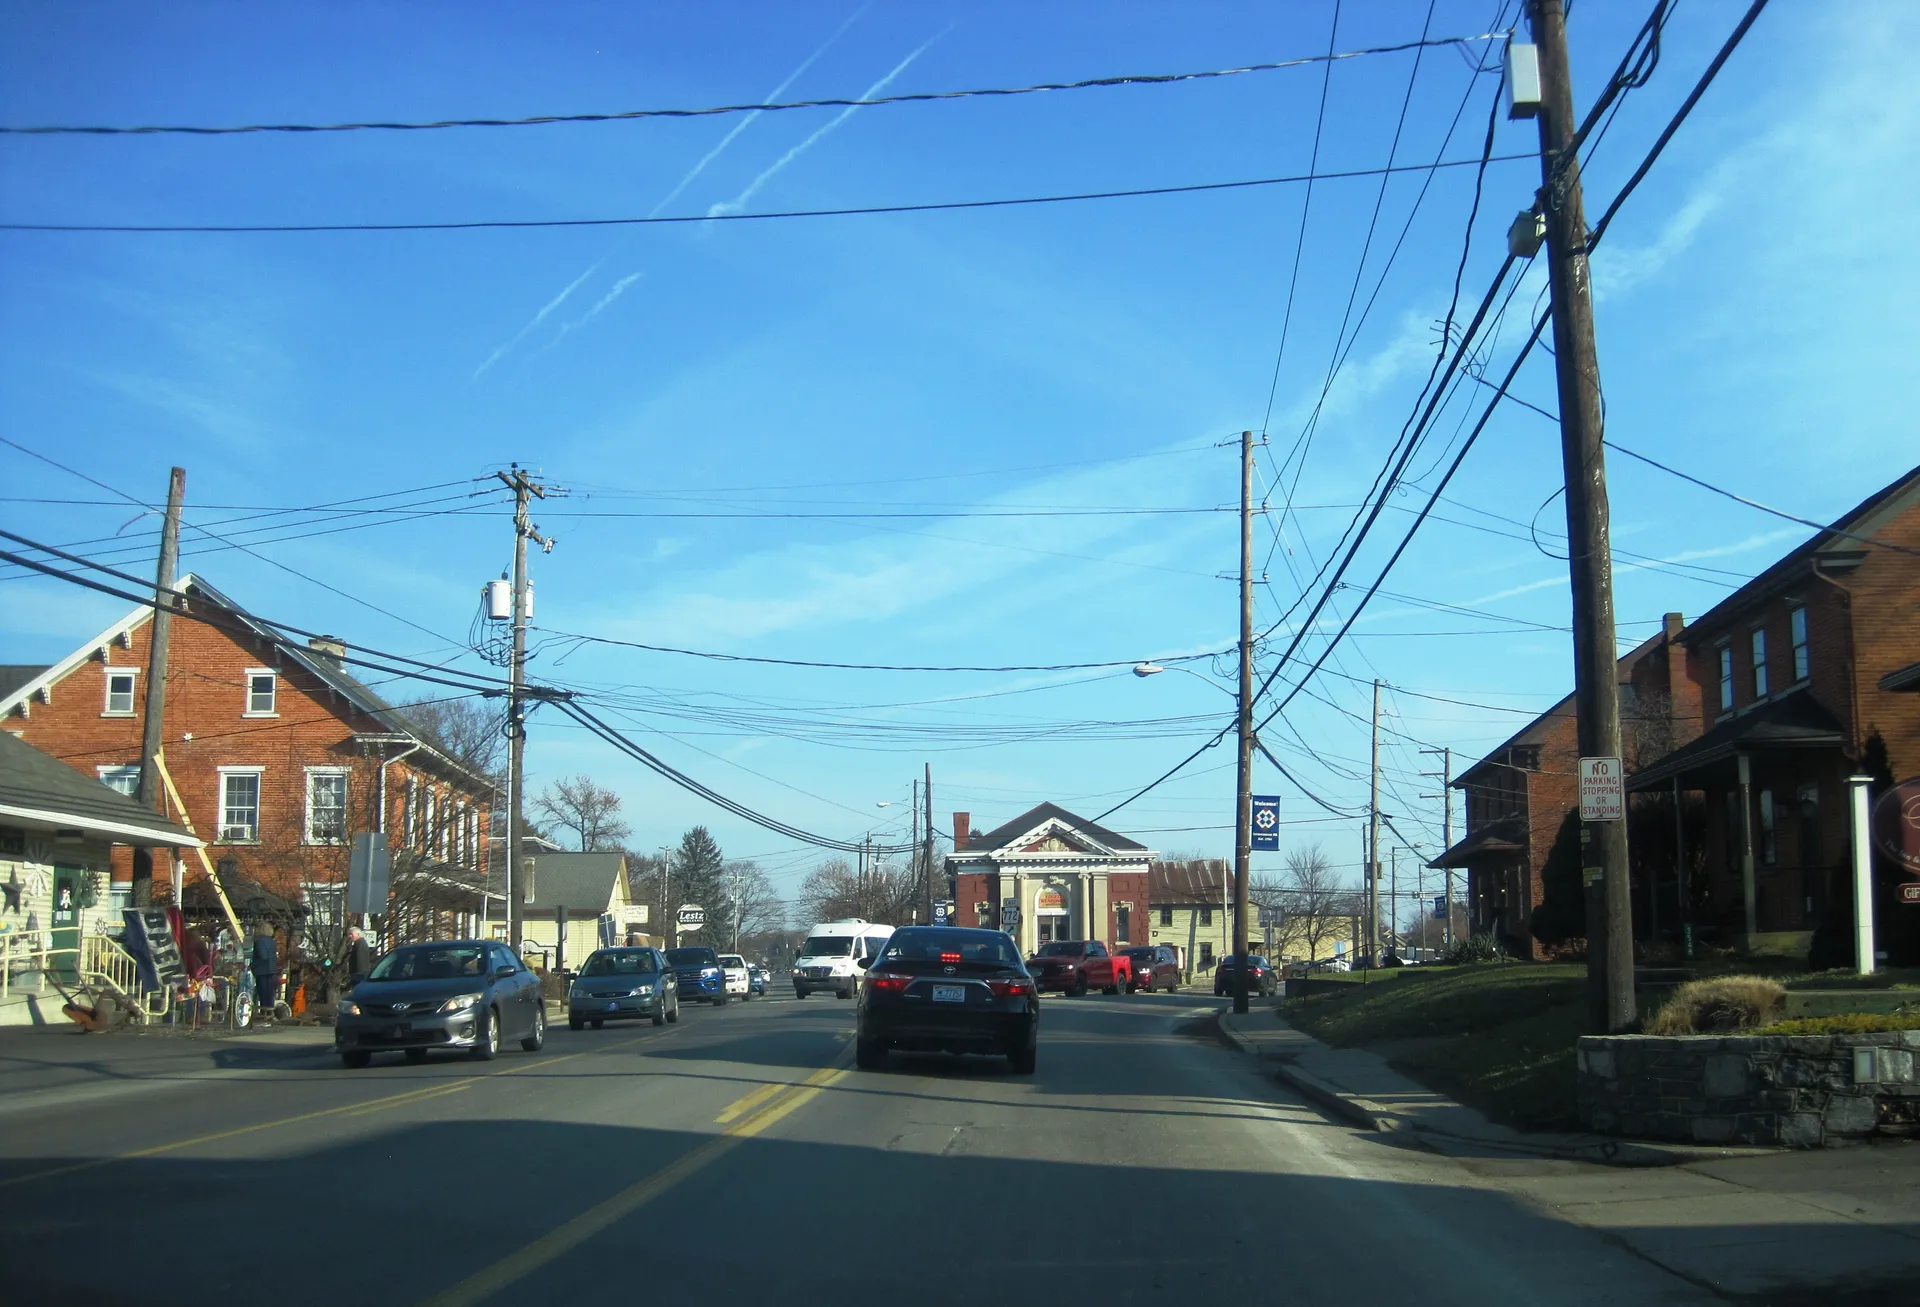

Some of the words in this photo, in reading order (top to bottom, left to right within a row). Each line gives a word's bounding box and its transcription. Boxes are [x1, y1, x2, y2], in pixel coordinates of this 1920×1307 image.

[1592, 763, 1608, 775] NO
[1584, 776, 1617, 785] PARKING
[1583, 786, 1620, 796] STOPPING
[1596, 796, 1607, 805] OR
[1583, 806, 1621, 815] STANDING
[679, 911, 705, 920] Lestz
[1003, 910, 1018, 921] 772
[1152, 930, 1159, 938] D
[144, 912, 183, 985] OPEN
